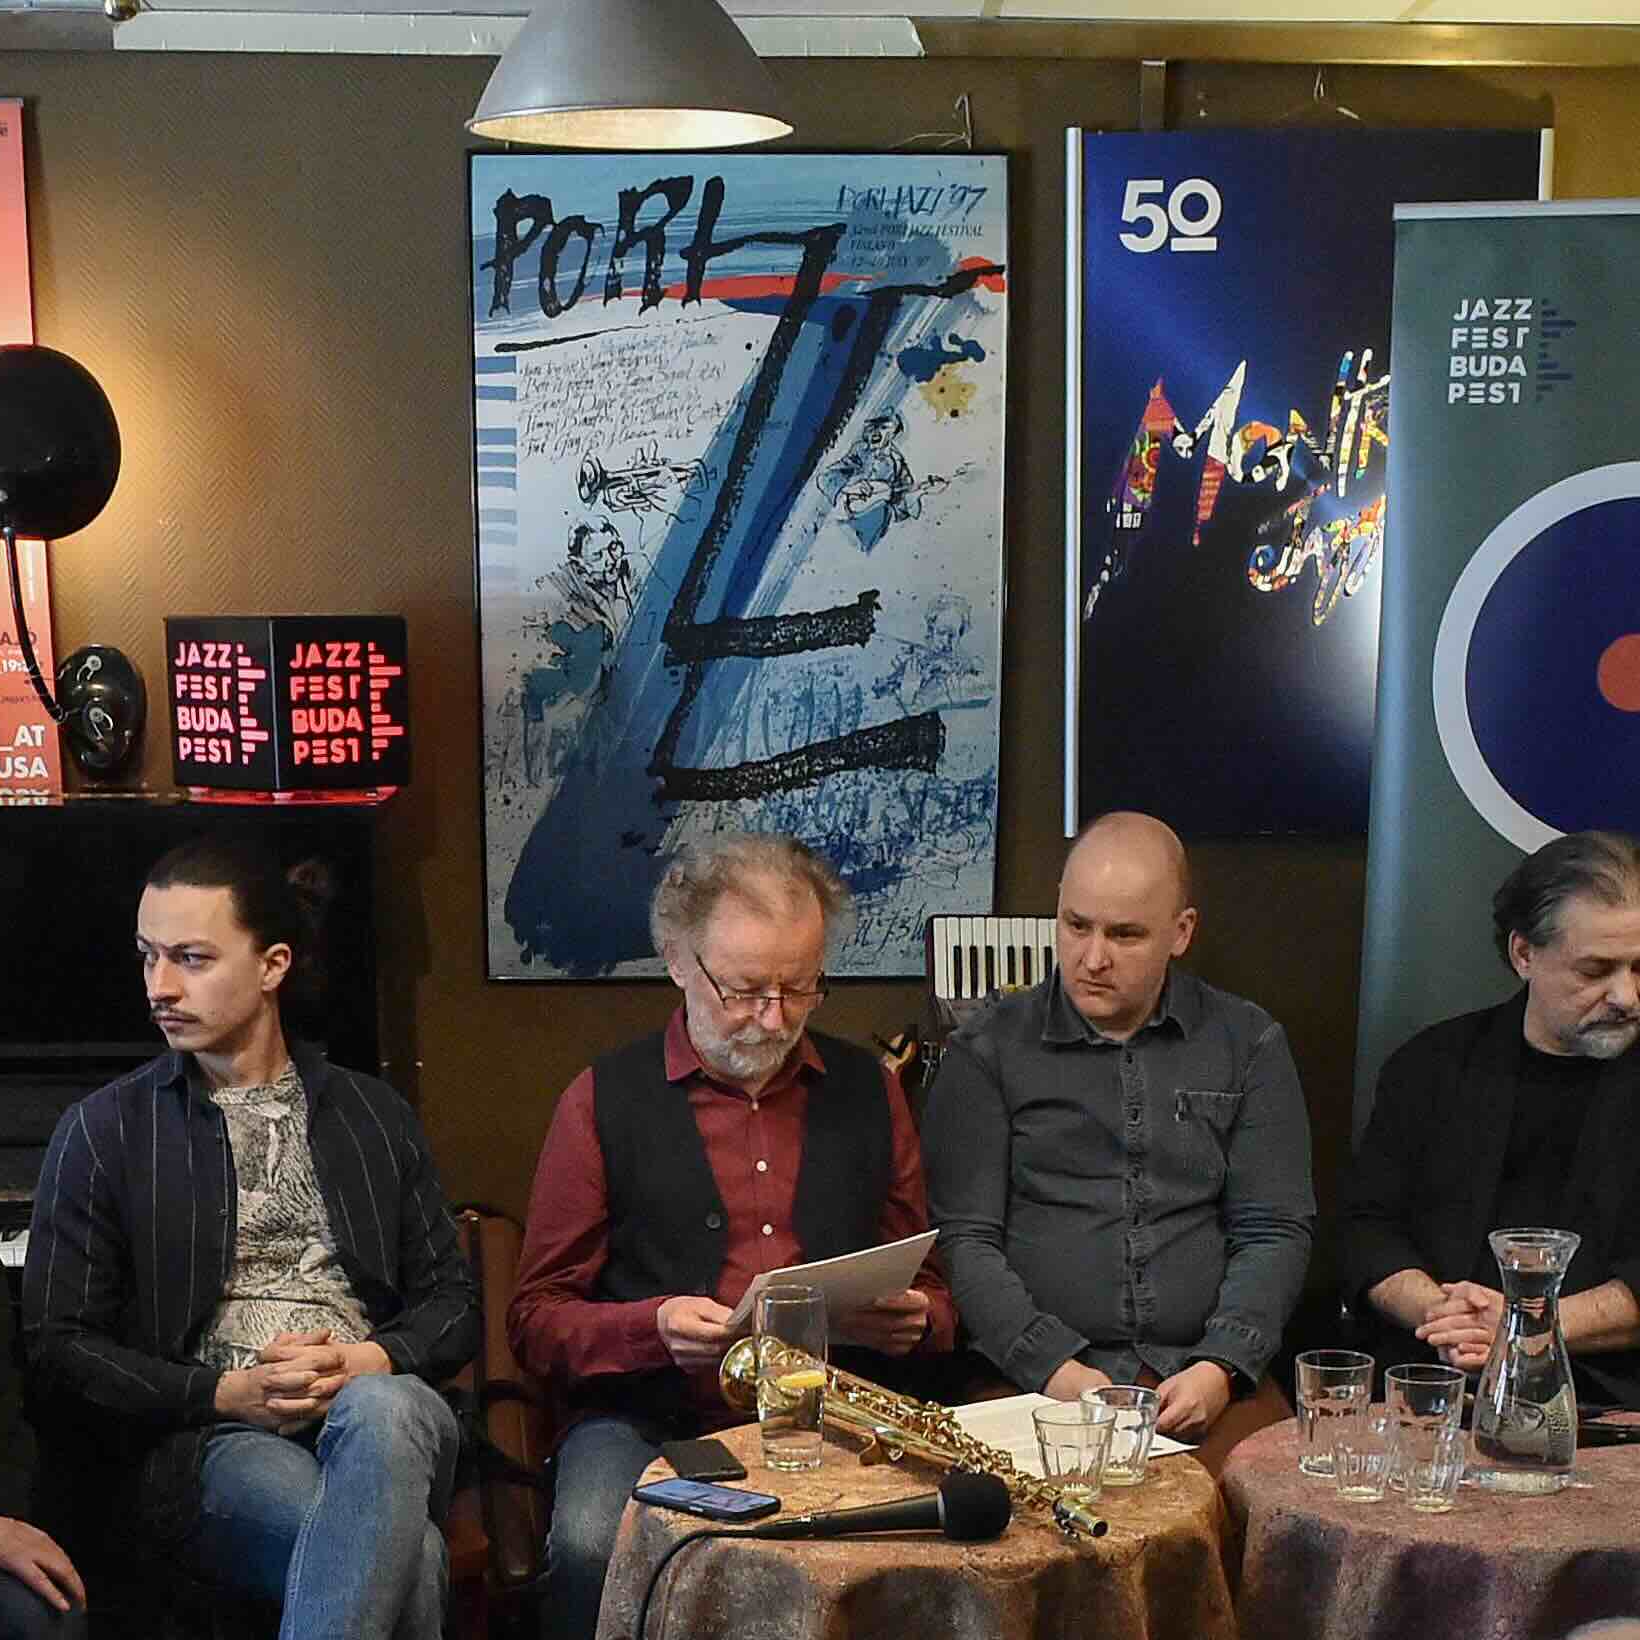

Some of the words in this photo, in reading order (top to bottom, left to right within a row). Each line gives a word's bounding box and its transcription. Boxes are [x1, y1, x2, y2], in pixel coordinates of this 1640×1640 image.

[1118, 178, 1223, 253] 50
[1452, 298, 1533, 321] JAZZ
[1450, 327, 1533, 349] FEST
[1449, 355, 1527, 377] BUDA
[1447, 382, 1521, 404] PEST
[175, 642, 232, 668] JAZZ
[289, 642, 363, 668] JAZZ
[175, 675, 232, 701] FEST
[289, 674, 363, 701] FEST
[176, 706, 235, 732] BUDA
[291, 705, 364, 734] BUDA
[178, 738, 232, 764] PEST
[293, 737, 361, 765] PEST
